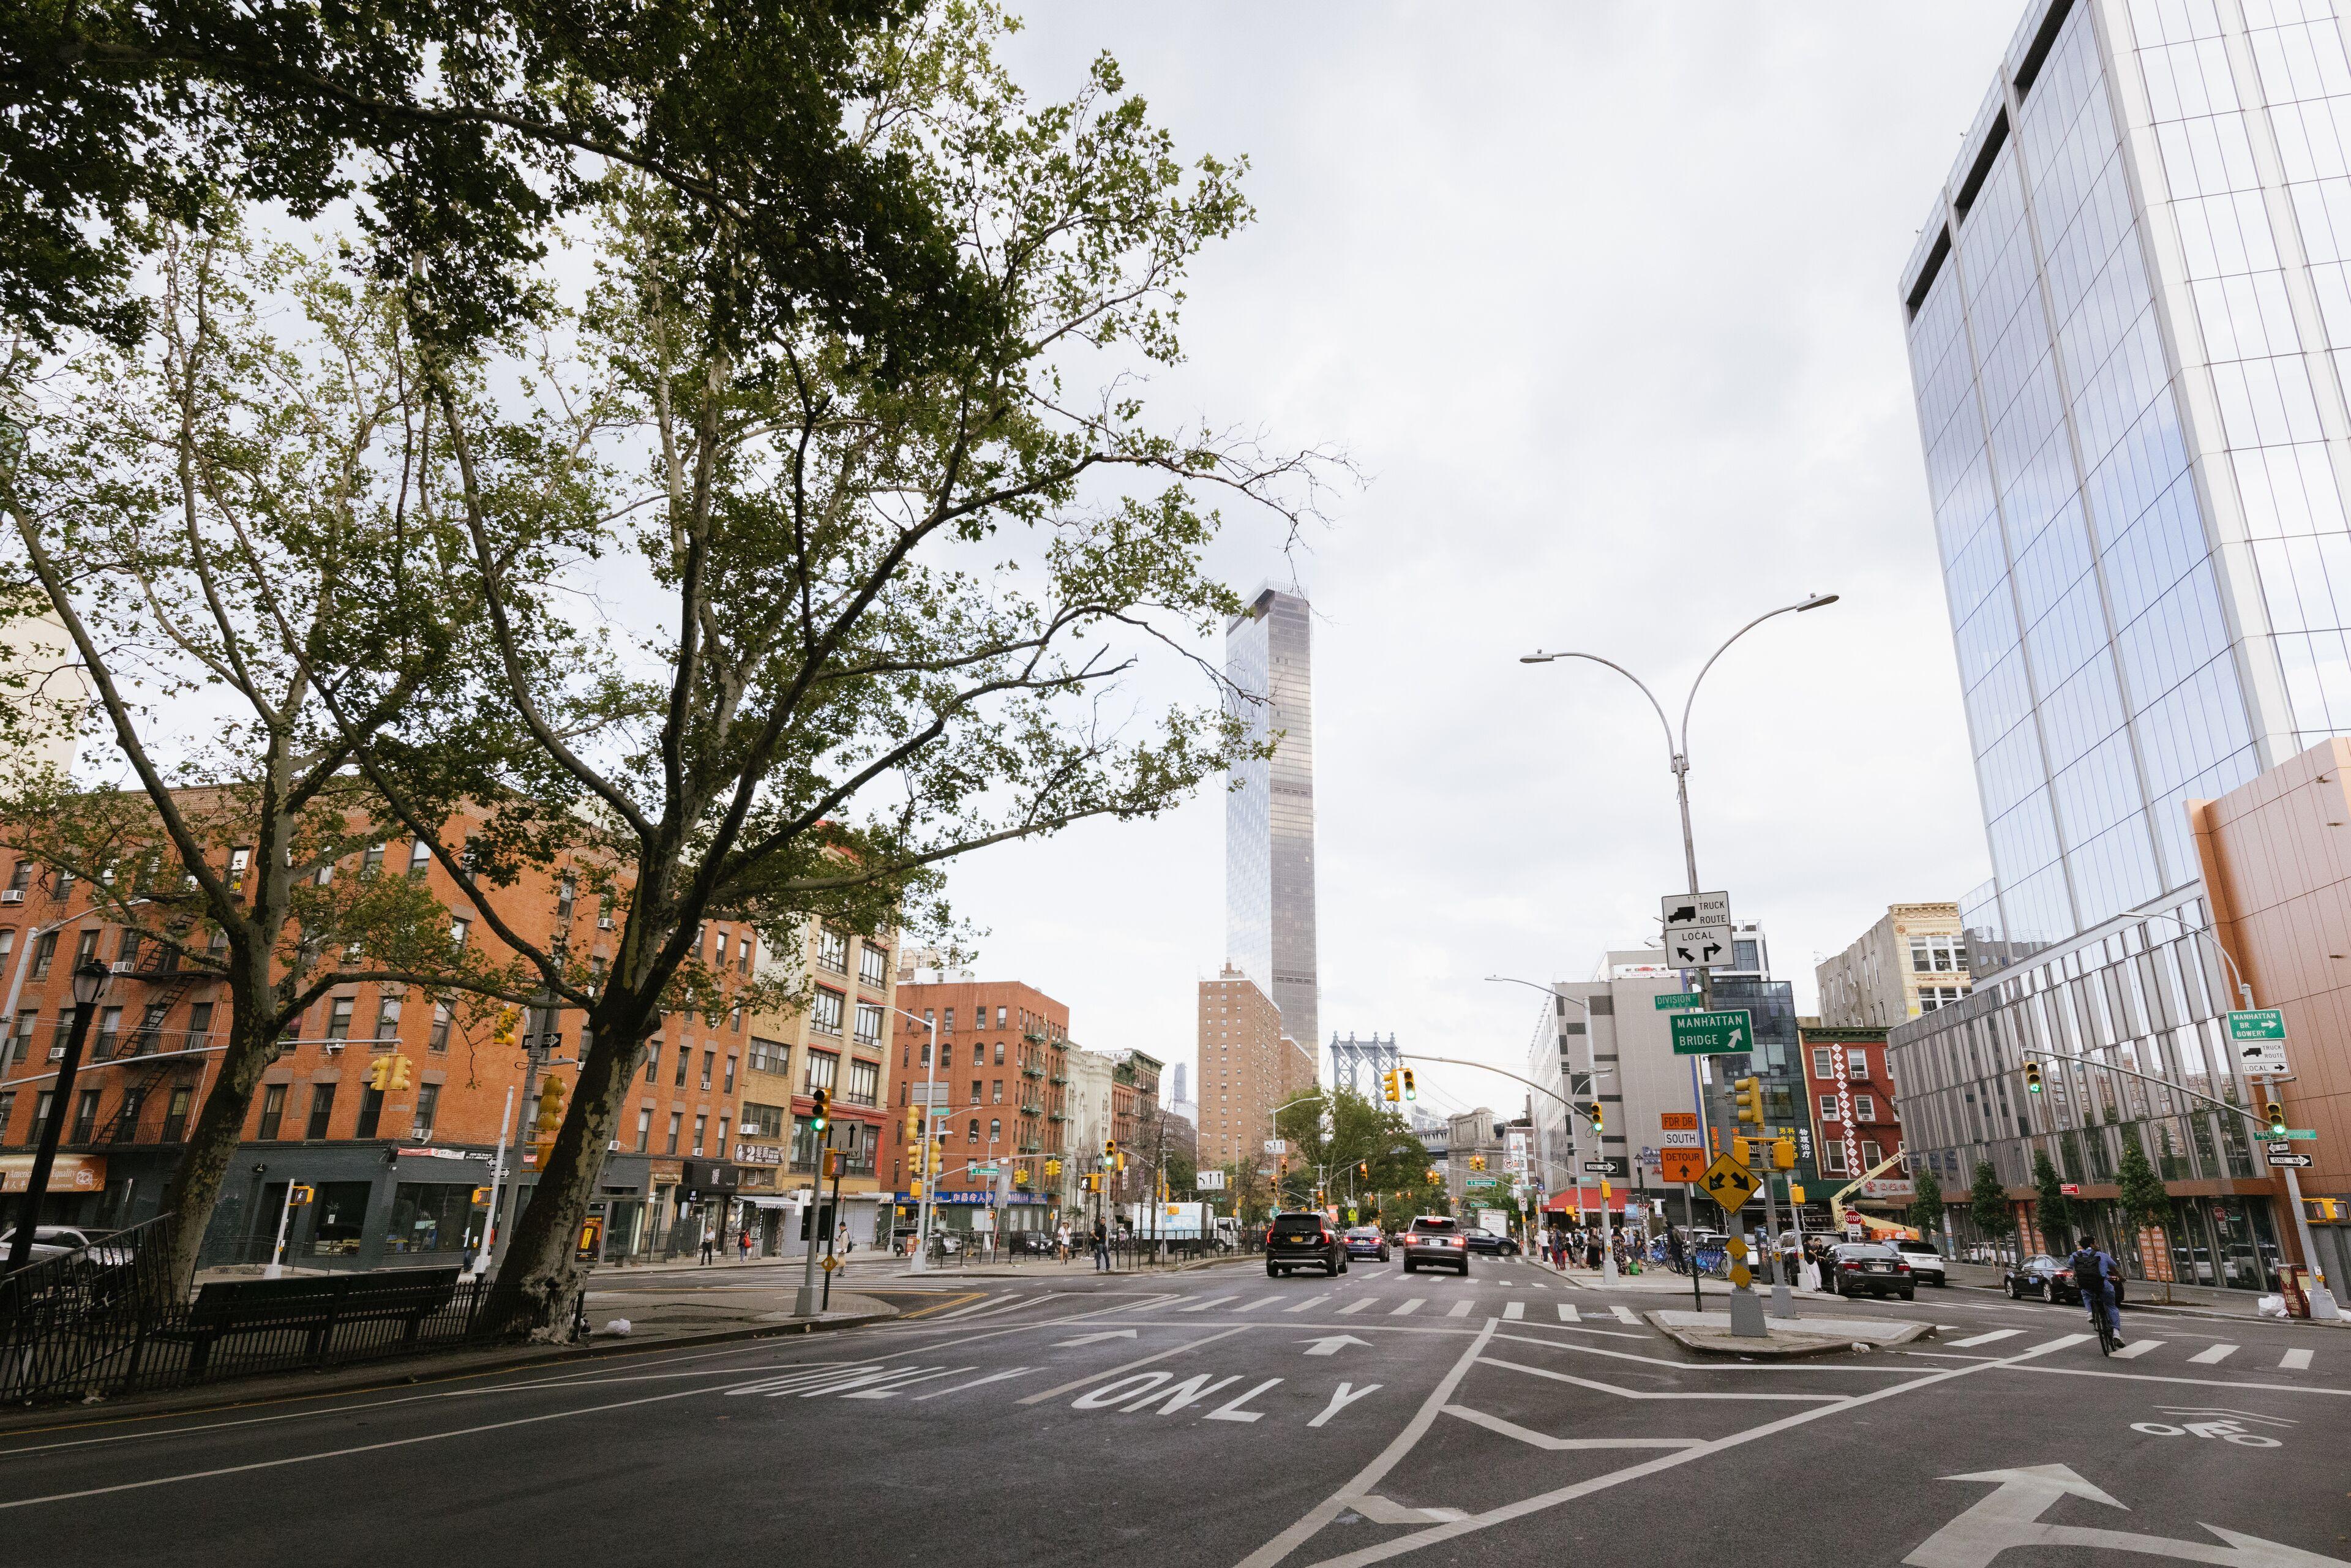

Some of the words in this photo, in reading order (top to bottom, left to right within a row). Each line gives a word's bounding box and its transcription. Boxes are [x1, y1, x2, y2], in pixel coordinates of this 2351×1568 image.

[1699, 901, 1725, 910] TRUCK
[1700, 915, 1726, 924] ROUTE
[1682, 931, 1714, 941] LOCAL
[1657, 995, 1690, 1004] DIVISION
[1677, 1015, 1742, 1028] MANHATTAN
[1679, 1035, 1718, 1046] BRIDGE
[1664, 1117, 1679, 1127] FDR
[1682, 1116, 1693, 1126] DR
[1667, 1133, 1696, 1144] SOUTH
[746, 1146, 755, 1161] 2
[1666, 1153, 1700, 1161] DETOUR
[51, 1169, 76, 1179] Equality
[2285, 1294, 2298, 1304] LOVE
[724, 1366, 1049, 1400] ONLY
[1071, 1371, 1383, 1427] ONLY
